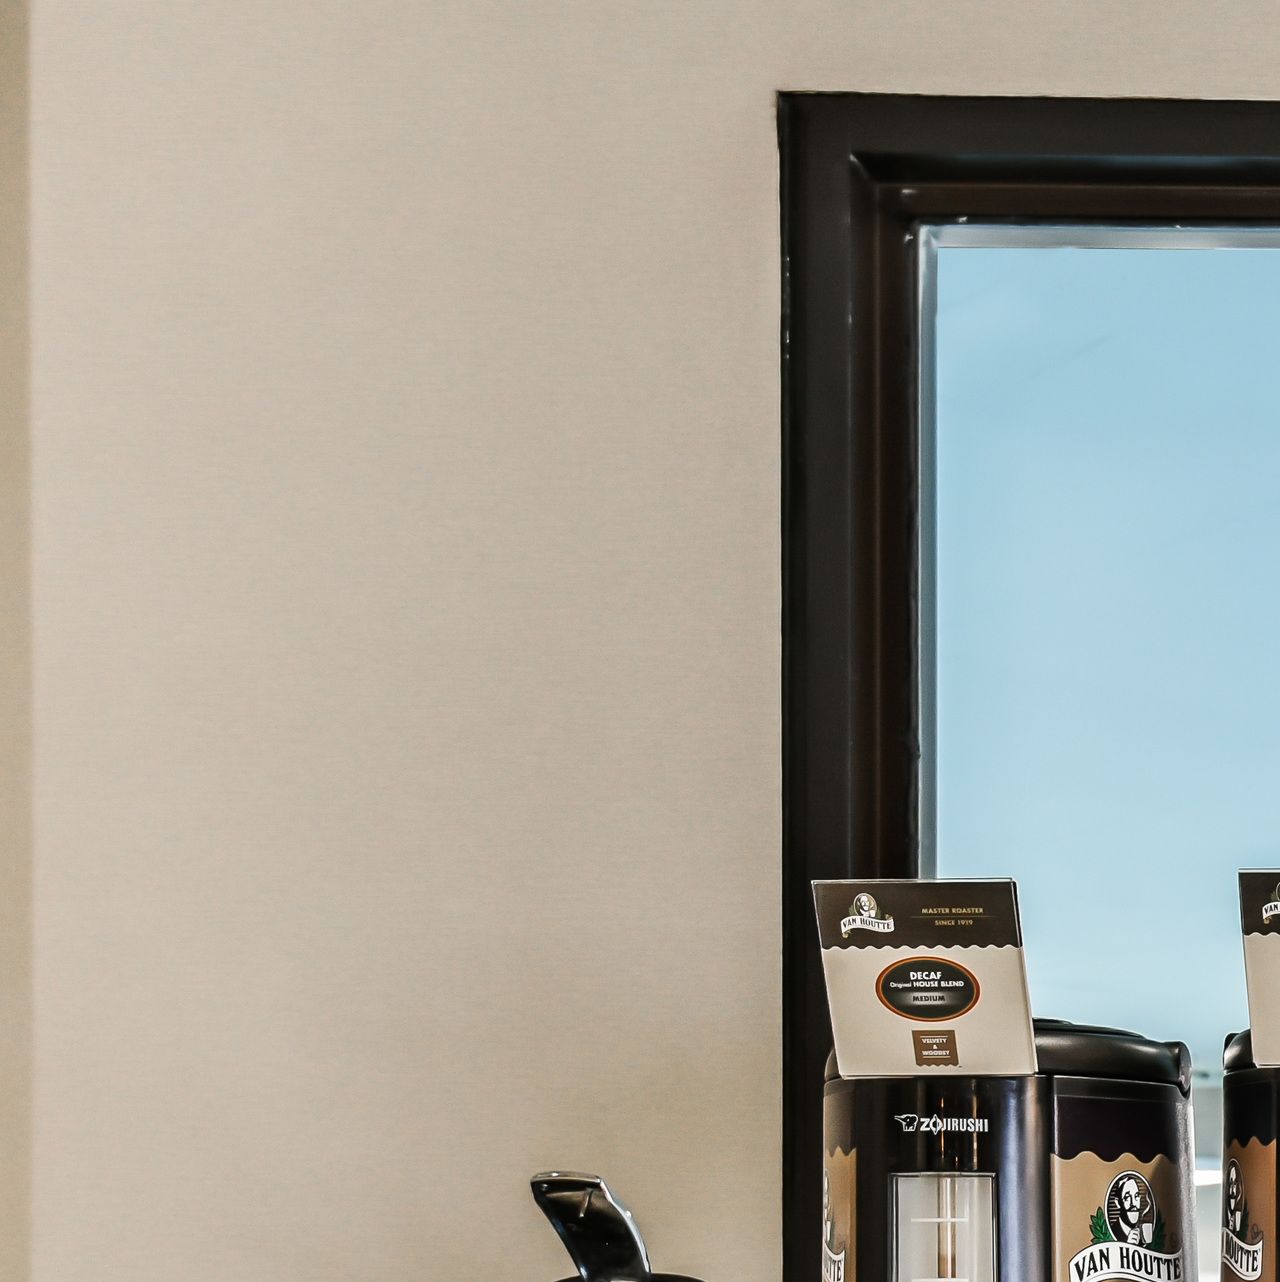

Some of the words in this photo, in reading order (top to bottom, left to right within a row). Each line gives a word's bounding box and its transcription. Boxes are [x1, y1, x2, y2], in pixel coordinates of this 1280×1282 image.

[1264, 903, 1278, 915] VAN
[843, 918, 857, 928] VAN
[861, 918, 892, 930] HOUTTE
[910, 972, 941, 980] DECAF
[920, 1114, 988, 1135] ZOJIRUSHI
[1225, 1236, 1258, 1273] HOUTTE
[1074, 1248, 1110, 1282] VAN
[1120, 1247, 1181, 1280] HOUTTE
